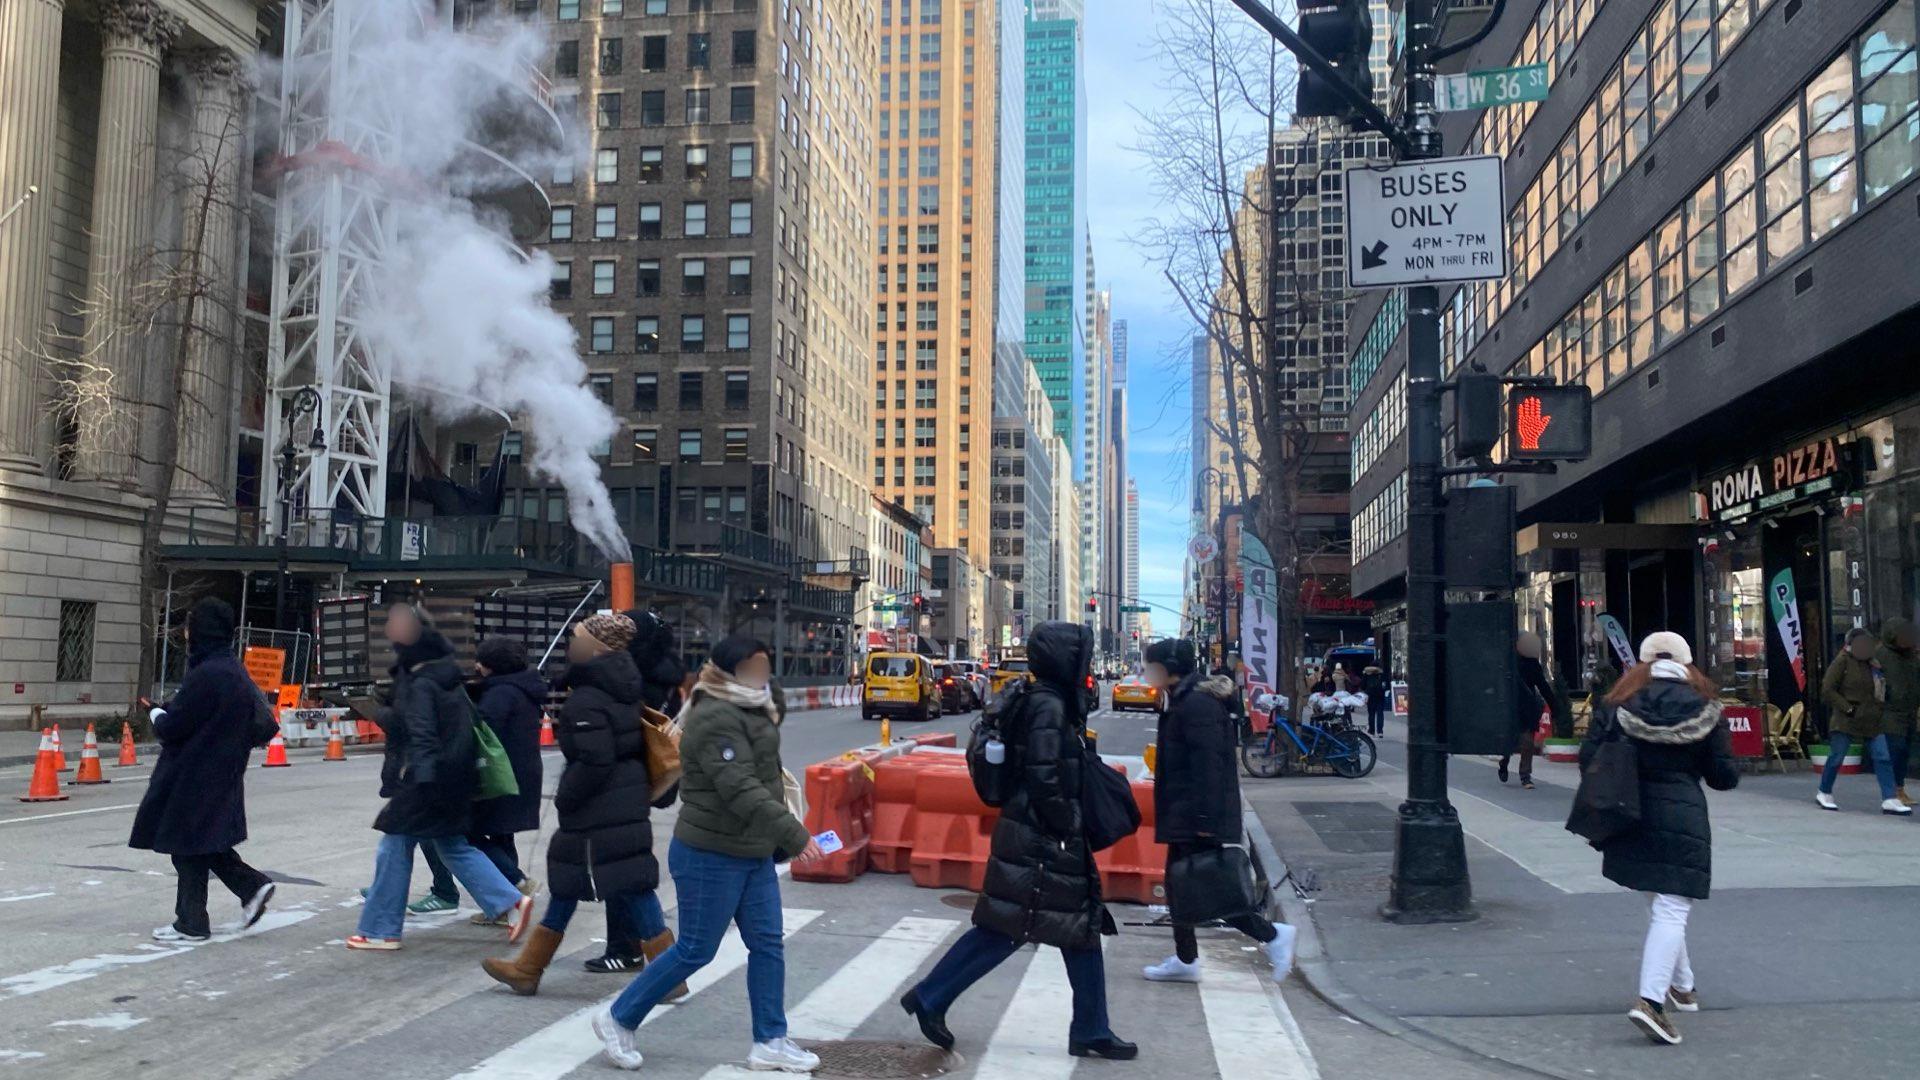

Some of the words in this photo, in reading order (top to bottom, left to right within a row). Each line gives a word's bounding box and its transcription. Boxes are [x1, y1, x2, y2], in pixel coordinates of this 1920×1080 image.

[1469, 75, 1487, 104] W
[1495, 73, 1521, 100] 36
[1529, 68, 1544, 87] St
[1381, 171, 1467, 198] BUSES
[1391, 203, 1458, 229] ONLY
[1412, 237, 1443, 250] 4PM
[1455, 234, 1486, 248] 7PM
[1405, 256, 1435, 271] MON
[1441, 255, 1466, 266] THRU
[1471, 251, 1494, 266] FRI
[1711, 464, 1764, 512] ROMA
[1773, 437, 1838, 490] PIZZA
[1851, 561, 1863, 629] ROM
[1727, 717, 1751, 732] ZZA
